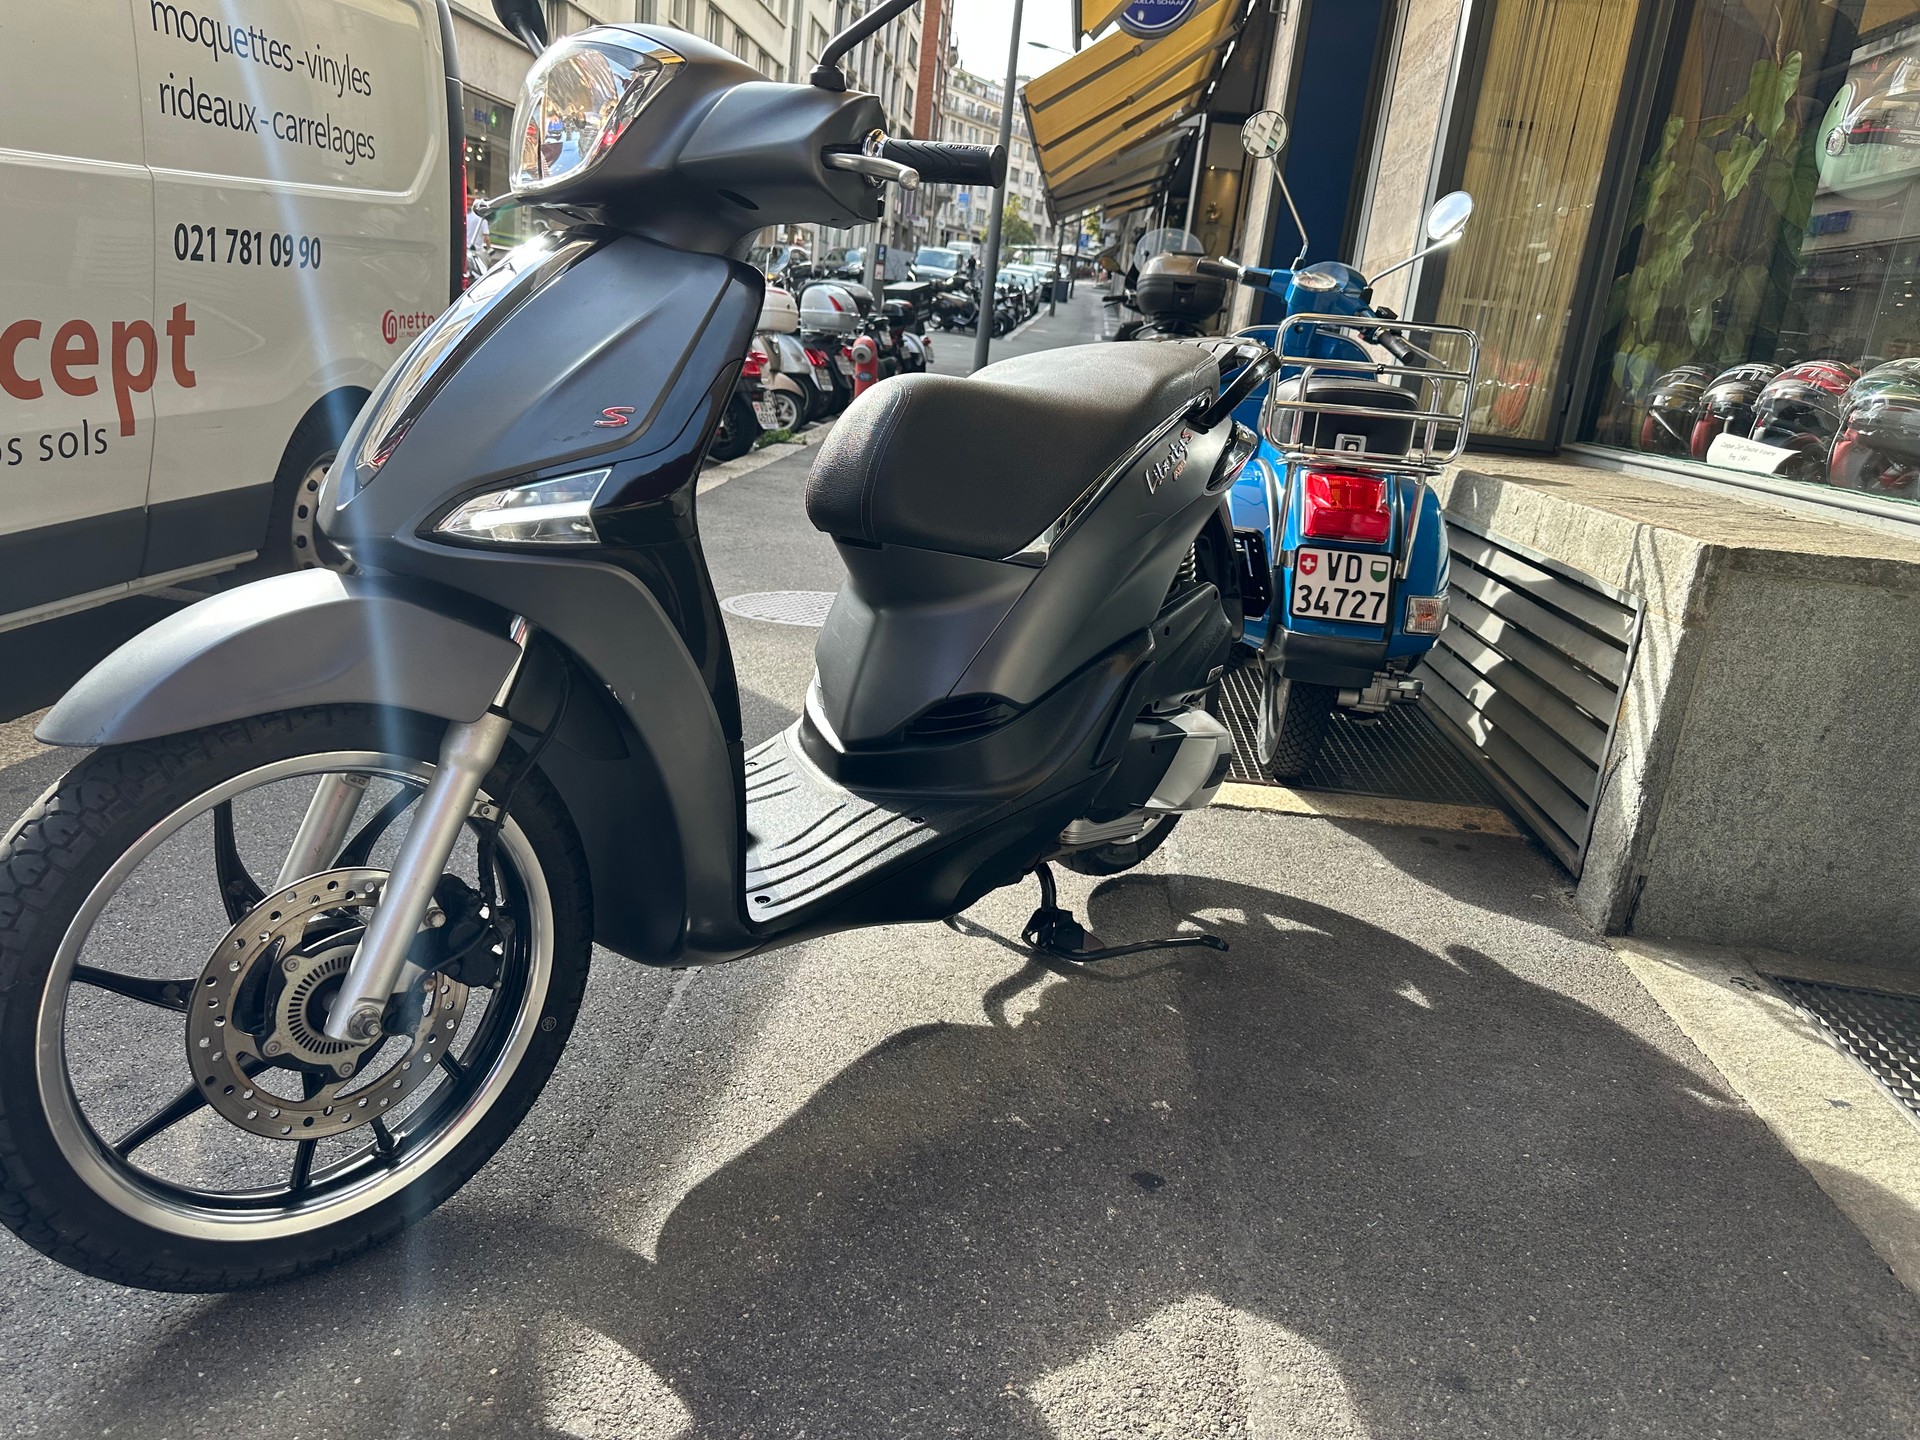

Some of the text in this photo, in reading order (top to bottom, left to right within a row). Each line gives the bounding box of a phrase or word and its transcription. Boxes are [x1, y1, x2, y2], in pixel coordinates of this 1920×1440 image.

[174, 223, 321, 270] 021 781 09 90
[0, 302, 197, 437] cept
[593, 406, 636, 428] S
[0, 419, 108, 466] s sols
[1327, 552, 1363, 583] VD
[1296, 585, 1386, 621] 34727
